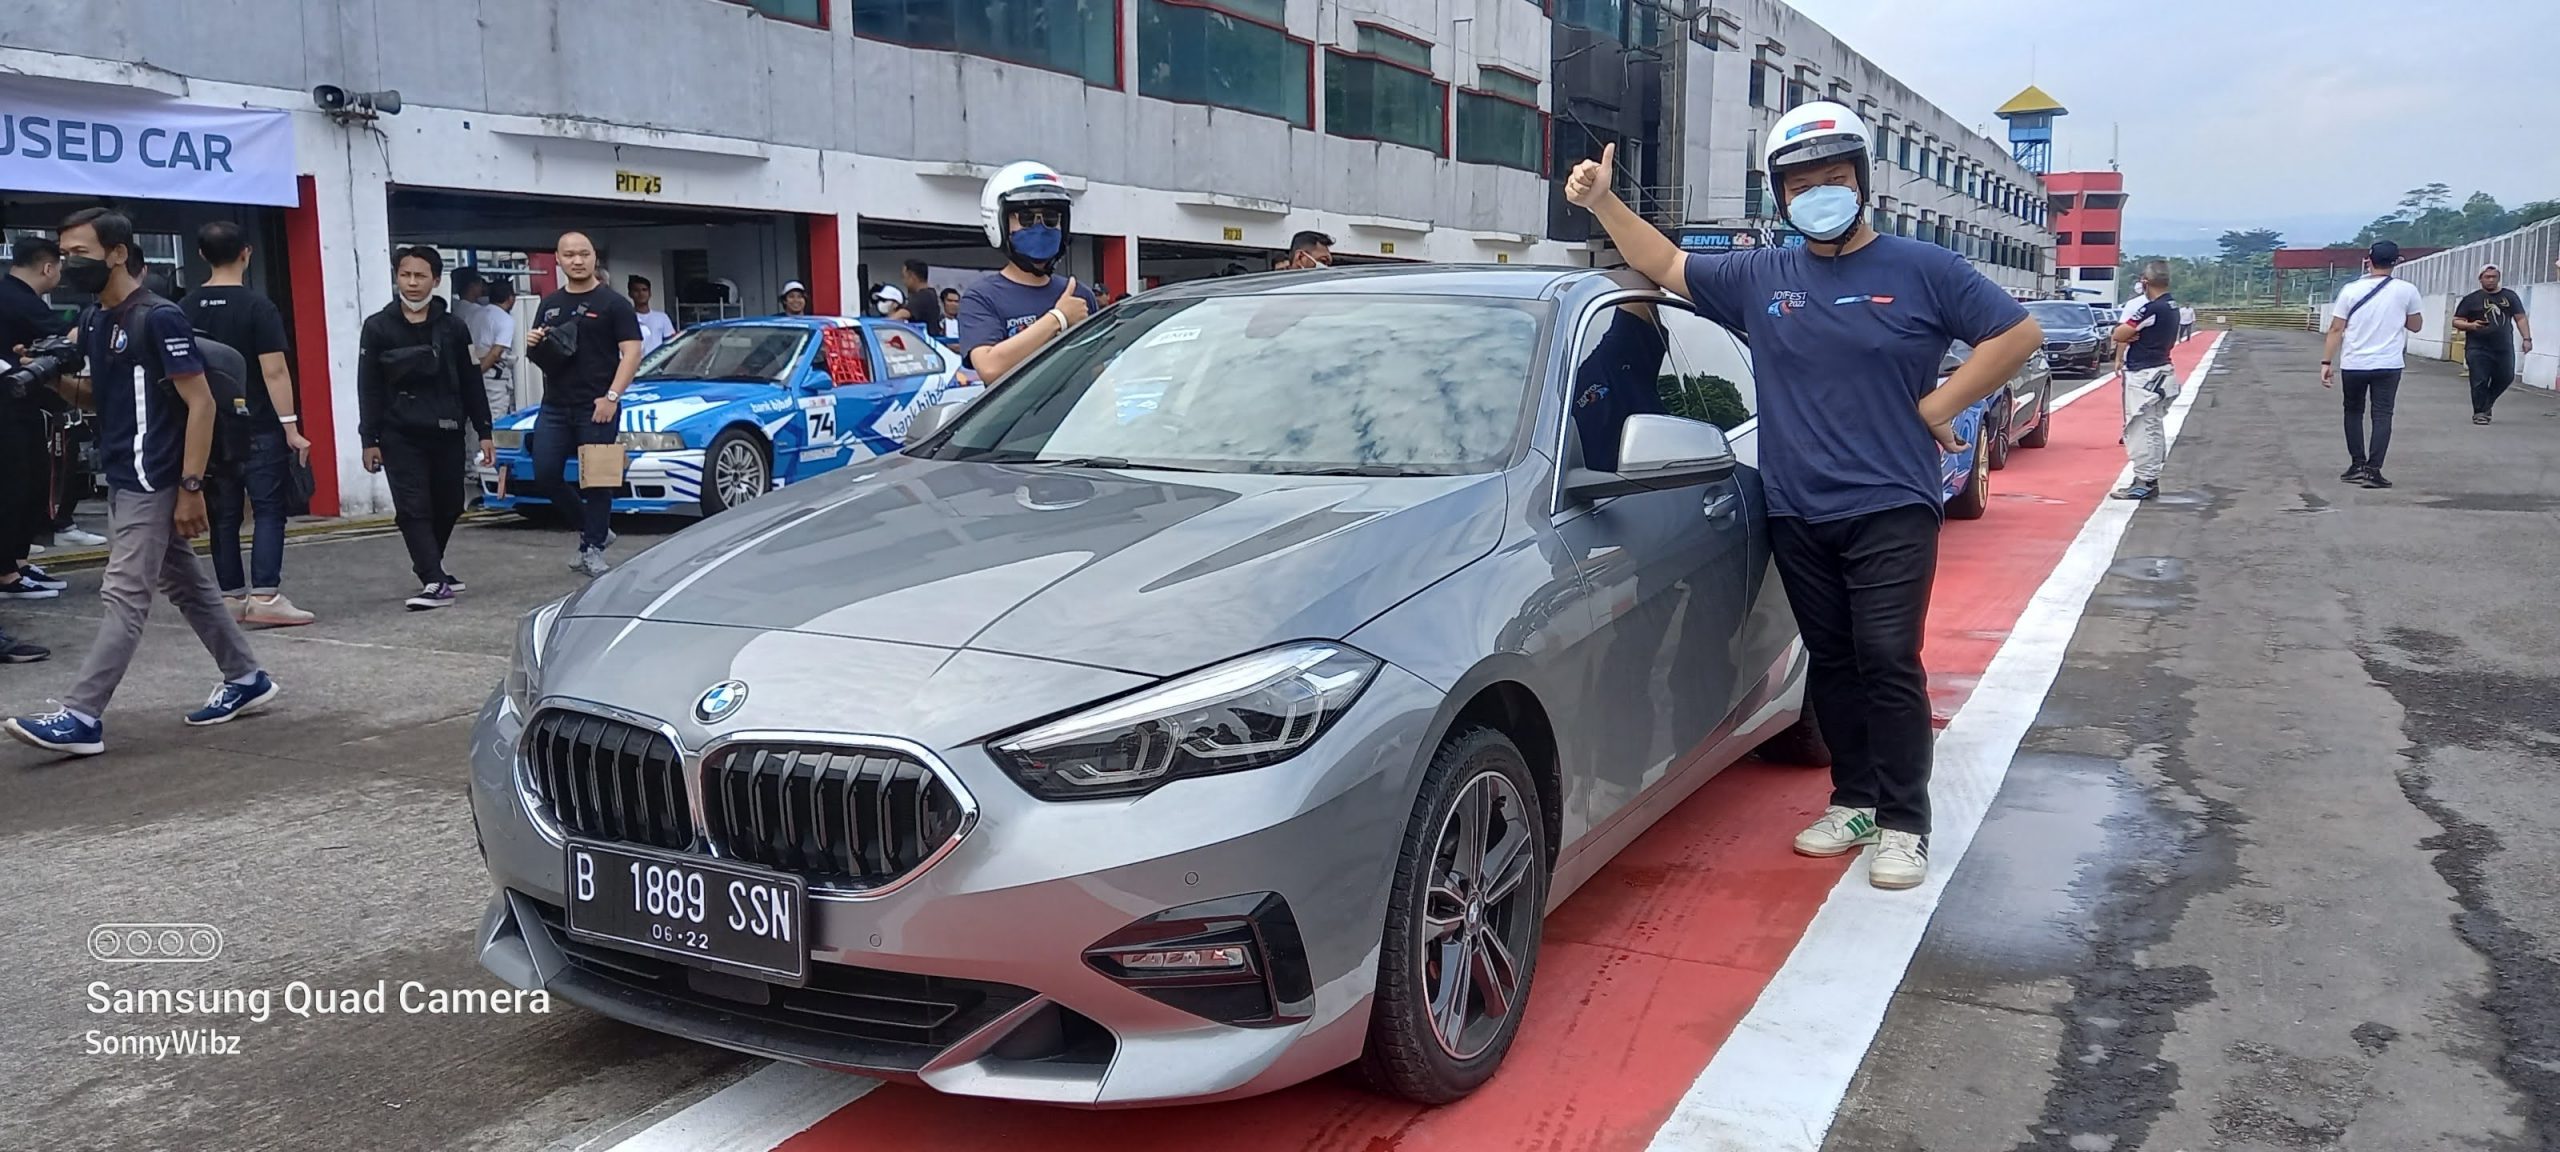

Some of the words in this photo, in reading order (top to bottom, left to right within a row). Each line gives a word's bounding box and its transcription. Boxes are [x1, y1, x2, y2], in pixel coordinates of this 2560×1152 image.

[138, 127, 233, 173] CAR
[616, 174, 640, 191] PIT
[1681, 235, 1731, 246] SENTUL
[1772, 290, 1807, 300] JOYFEST
[1788, 300, 1806, 308] 2022
[809, 413, 835, 439] 74
[576, 852, 595, 901] B
[630, 862, 706, 923] 1889
[728, 881, 791, 943] SSN
